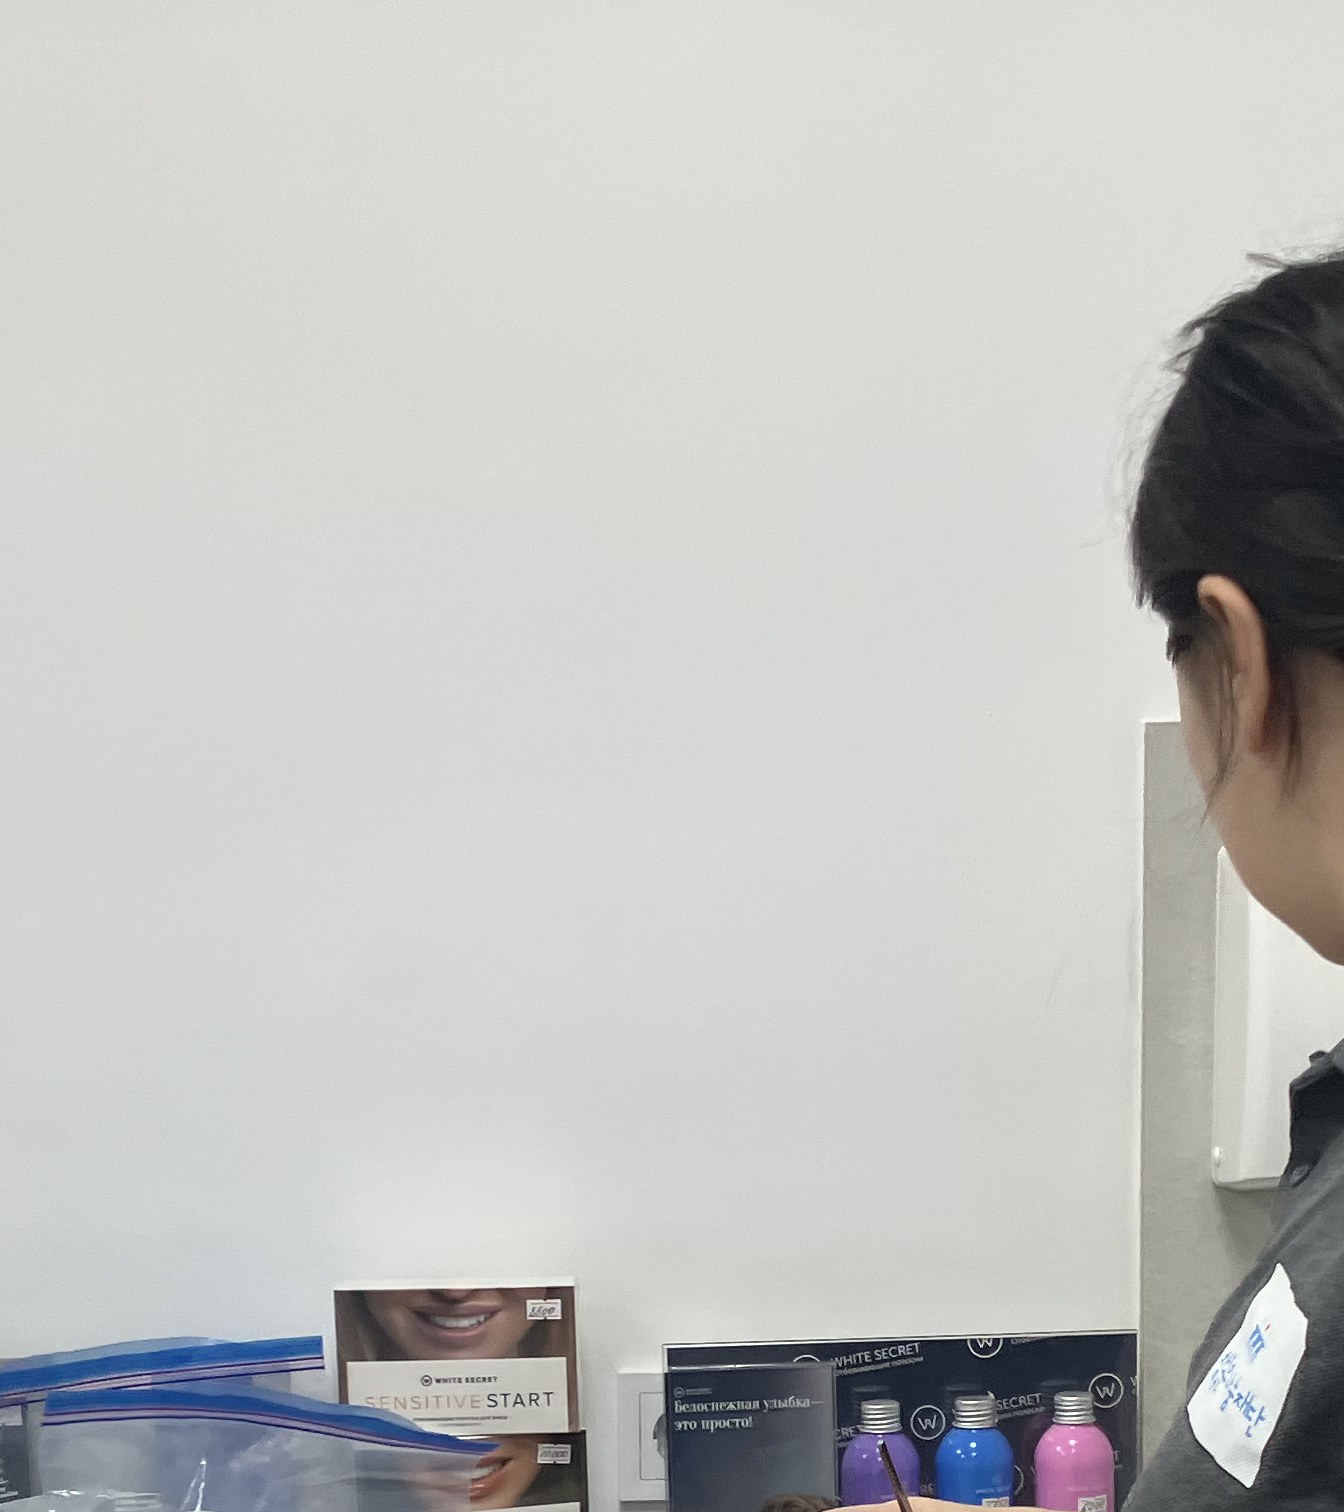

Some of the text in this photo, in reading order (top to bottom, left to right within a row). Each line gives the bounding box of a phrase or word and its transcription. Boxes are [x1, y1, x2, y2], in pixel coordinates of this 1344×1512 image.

[830, 1351, 872, 1367] WHITE
[874, 1342, 921, 1361] SECRET
[365, 1391, 555, 1411] SENSITIVE START
[674, 1416, 753, 1433] это просто!
